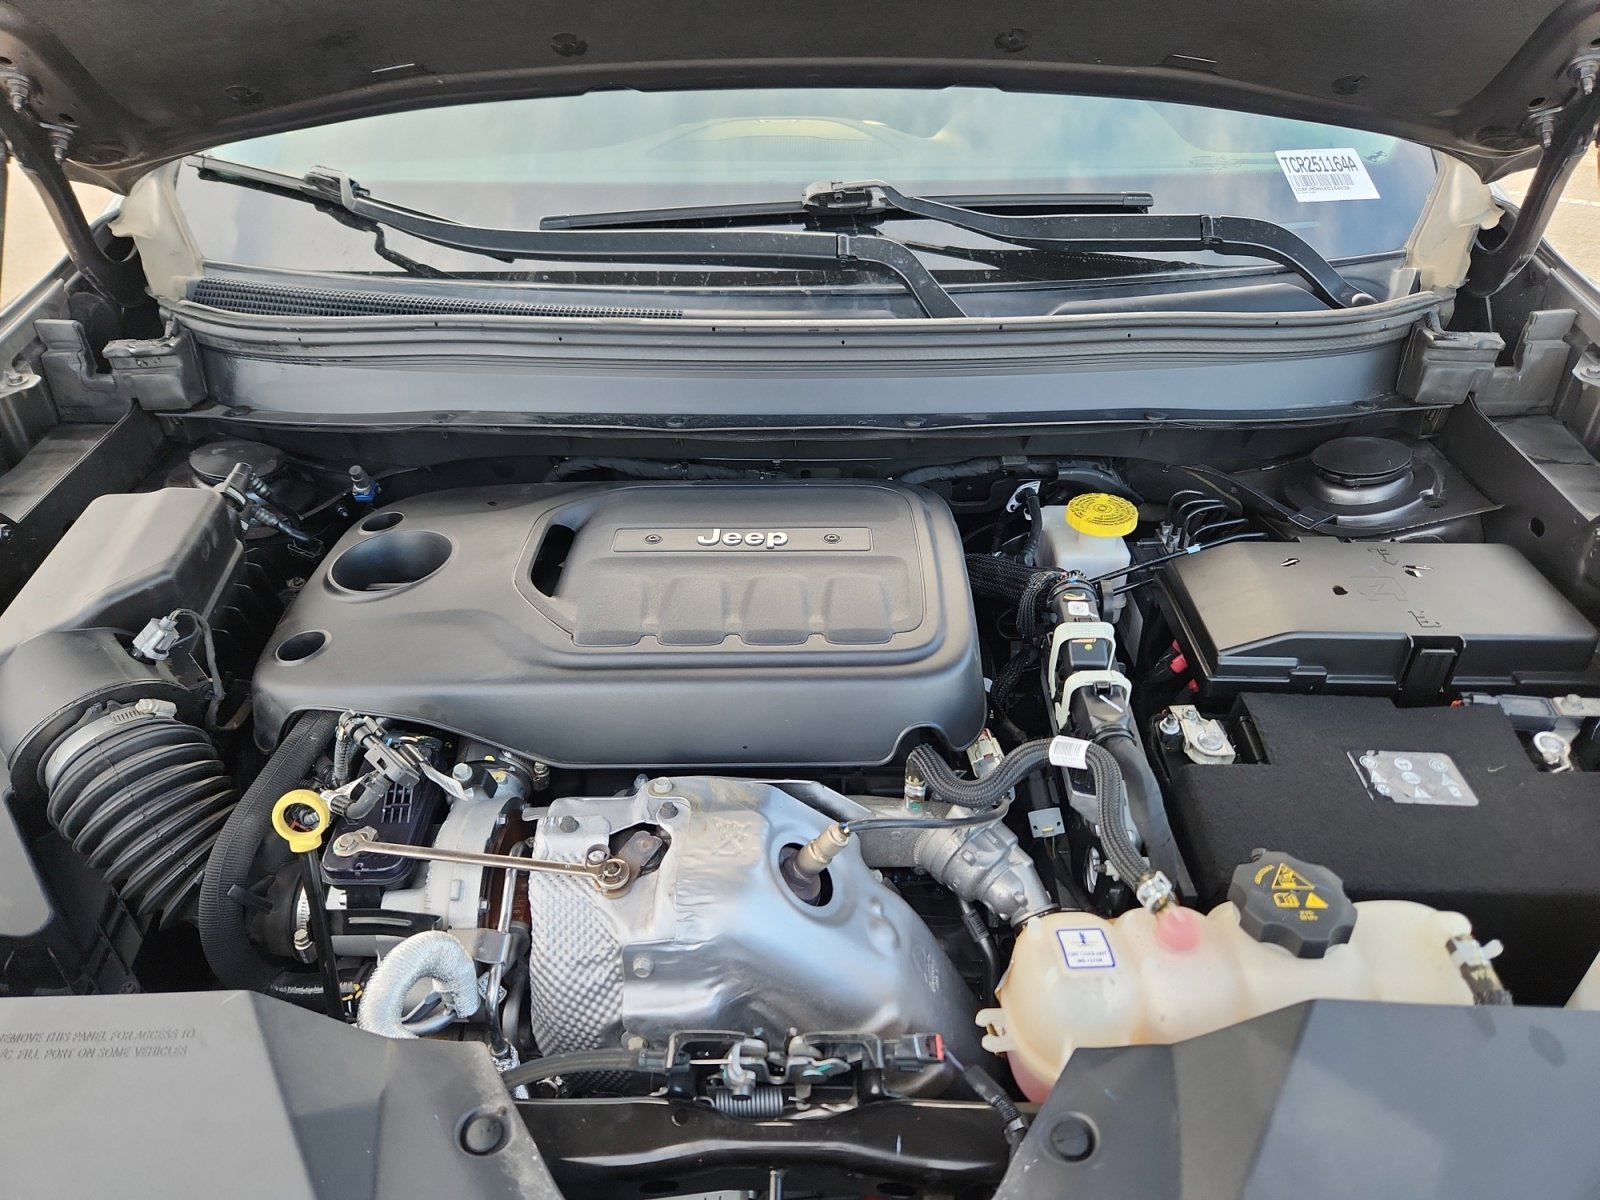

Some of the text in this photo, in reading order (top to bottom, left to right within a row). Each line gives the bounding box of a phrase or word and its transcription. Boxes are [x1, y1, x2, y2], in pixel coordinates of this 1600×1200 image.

[1281, 156, 1358, 173] TCR251164A
[697, 528, 788, 549] Jeep
[45, 1031, 71, 1042] THIS
[72, 1030, 108, 1042] PANEL
[110, 1029, 133, 1041] FOR
[181, 1027, 197, 1040] TO
[44, 1047, 76, 1060] PORT
[77, 1047, 97, 1058] ON
[97, 1047, 132, 1058] SOME
